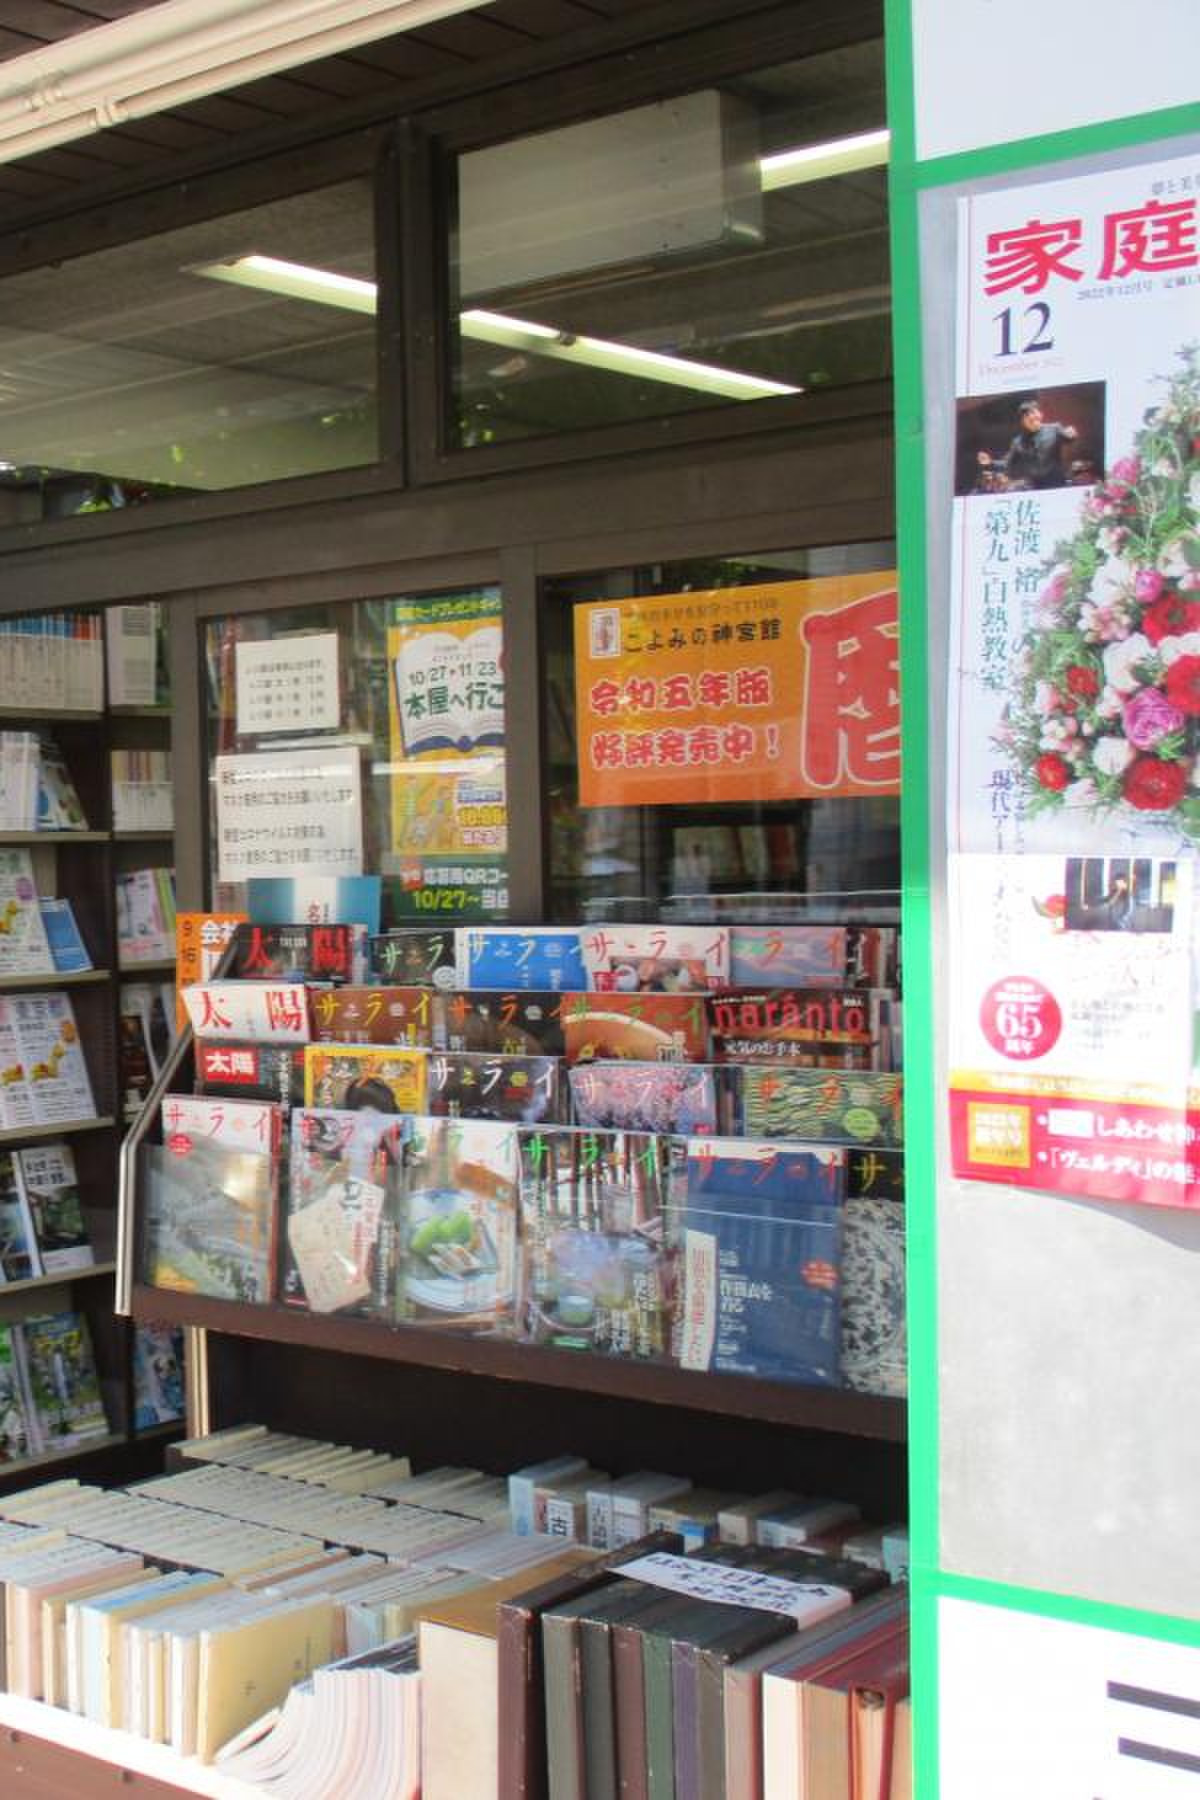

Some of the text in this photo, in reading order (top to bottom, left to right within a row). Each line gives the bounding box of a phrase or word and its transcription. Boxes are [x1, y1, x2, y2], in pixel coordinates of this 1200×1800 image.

[983, 200, 1199, 296] 家庭
[992, 301, 1055, 357] 12
[1014, 499, 1041, 555] 佐渡
[1014, 565, 1040, 595] 裕
[625, 618, 782, 653] こよみの神宮館
[590, 667, 772, 716] 令和五年版
[591, 724, 780, 768] 好評発売中!
[200, 990, 306, 1032] 太陽
[995, 1001, 1043, 1041] 65
[206, 1054, 255, 1074] 太陽
